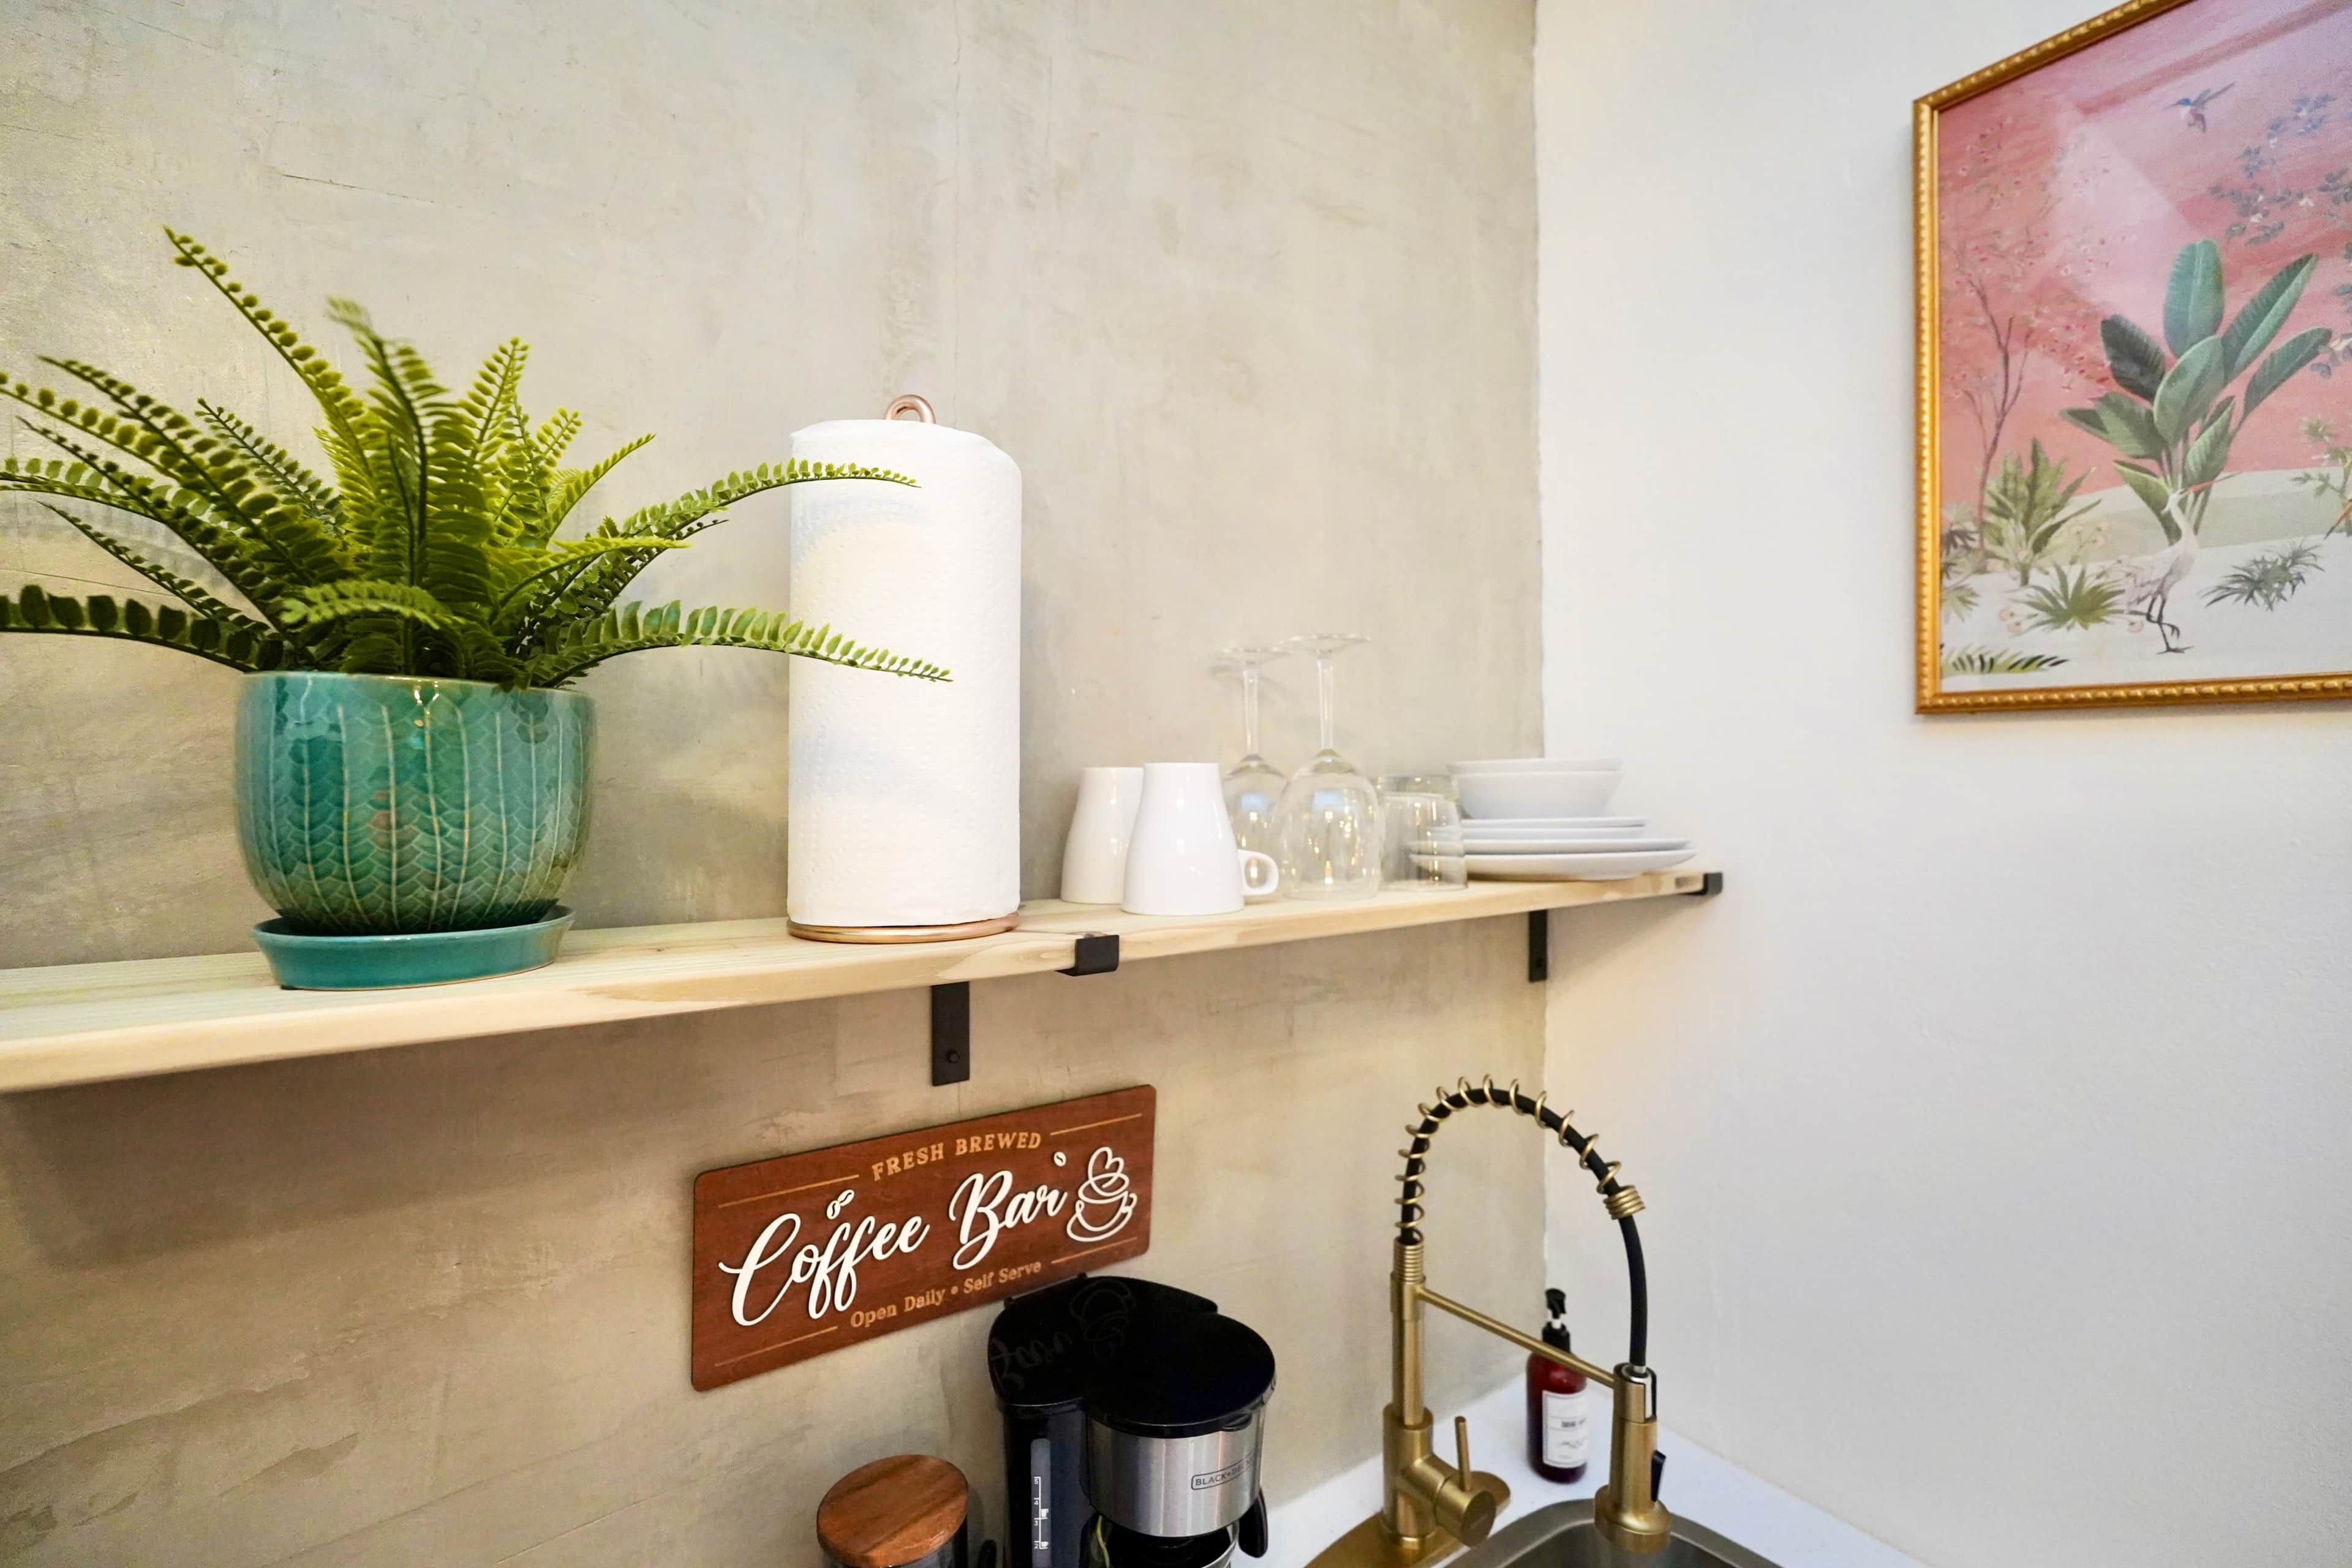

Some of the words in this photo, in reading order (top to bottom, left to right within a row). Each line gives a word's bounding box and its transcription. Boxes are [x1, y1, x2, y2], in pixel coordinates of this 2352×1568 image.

[872, 1142, 944, 1181] FRESH
[956, 1132, 1041, 1155] BREWED
[718, 1213, 930, 1327] Coffee
[949, 1170, 1068, 1270] Bar
[850, 1304, 897, 1328] Open
[903, 1288, 946, 1312] Daily
[963, 1271, 995, 1294] Self
[998, 1261, 1041, 1283] Serve
[1195, 1458, 1251, 1486] BLACK+DE
